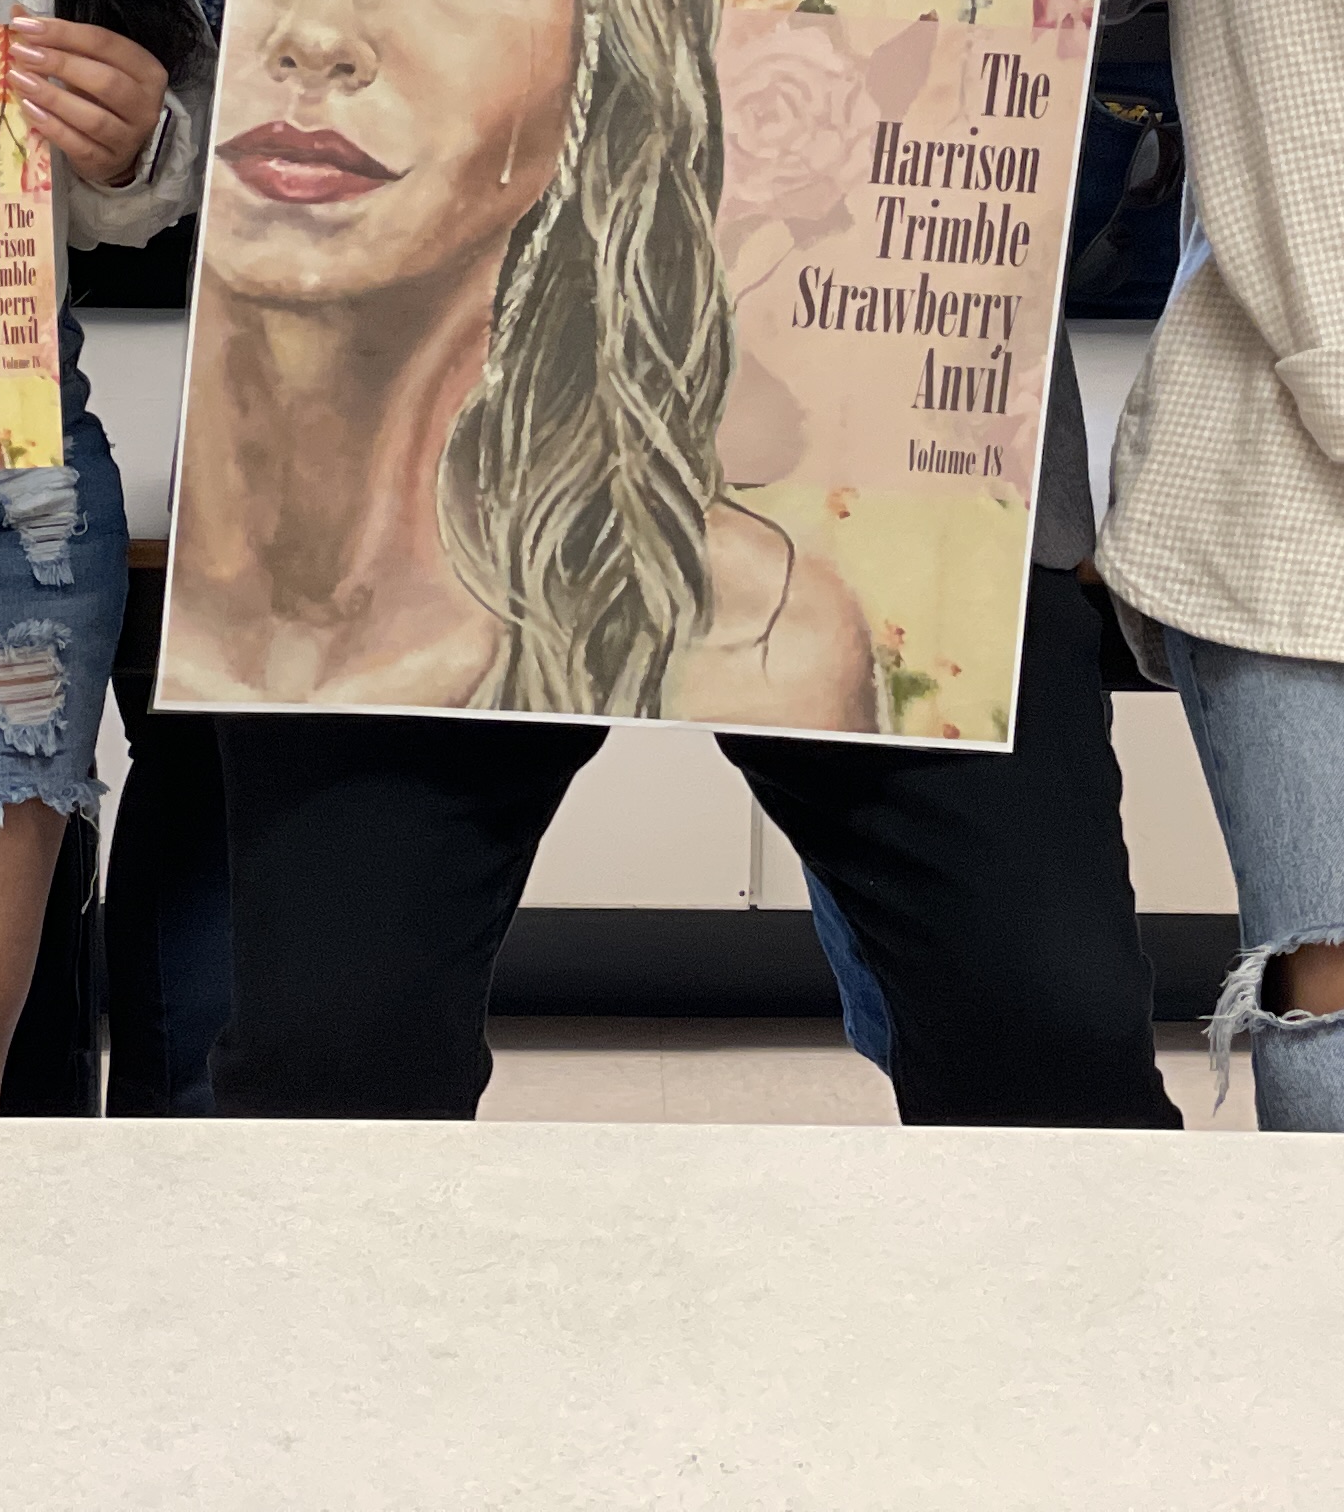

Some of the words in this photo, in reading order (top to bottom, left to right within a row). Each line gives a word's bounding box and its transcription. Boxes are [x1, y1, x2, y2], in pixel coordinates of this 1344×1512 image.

[980, 52, 1051, 120] The
[867, 120, 1041, 194] Harrison
[4, 202, 35, 229] The
[875, 195, 1031, 267] Trimble
[0, 317, 40, 345] Anvil
[791, 265, 1023, 355] Strawberry
[910, 347, 1013, 415] Anvil
[908, 438, 976, 476] Volume
[982, 444, 1004, 477] 18
